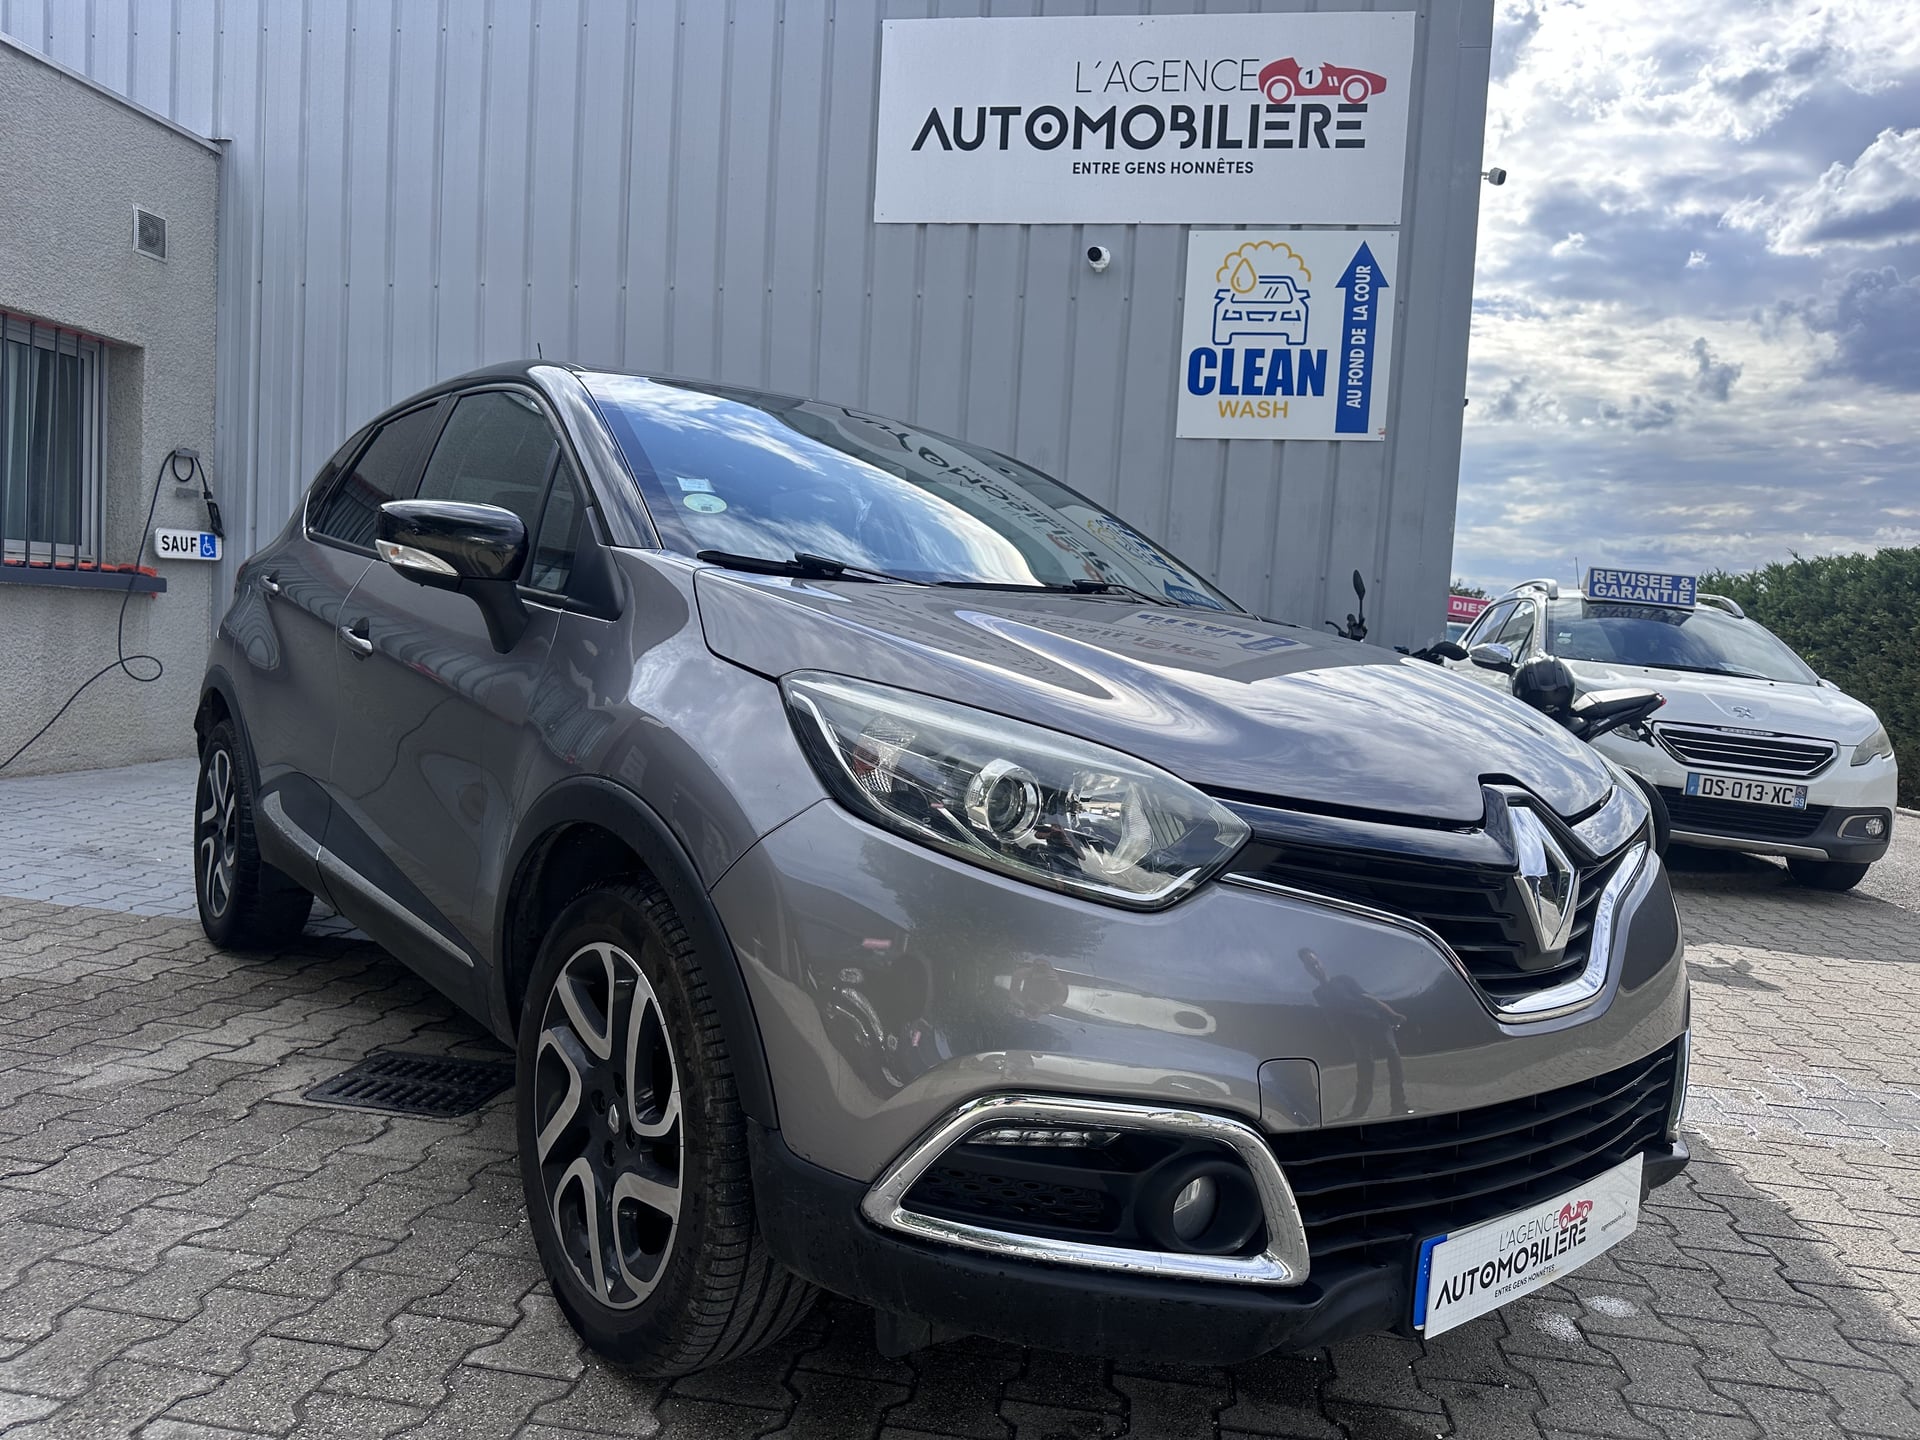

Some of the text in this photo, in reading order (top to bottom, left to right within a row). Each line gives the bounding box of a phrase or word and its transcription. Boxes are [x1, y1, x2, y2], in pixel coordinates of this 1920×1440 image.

[1075, 58, 1260, 93] L'AGENCE
[1305, 69, 1314, 85] 1
[1072, 157, 1254, 175] ENTRE GENS HONNÊTES
[1346, 265, 1372, 409] AU FOND DE LA COUR
[1187, 346, 1328, 397] CLEAN
[1218, 400, 1289, 419] WASH
[161, 534, 198, 553] SAUF
[1592, 569, 1693, 591] REVISEE &
[1593, 583, 1692, 604] GARANTIE
[1794, 797, 1805, 807] 69
[1499, 1209, 1561, 1253] L'AGENCE
[1494, 1283, 1513, 1298] ENTRE
[1512, 1276, 1529, 1290] GENS
